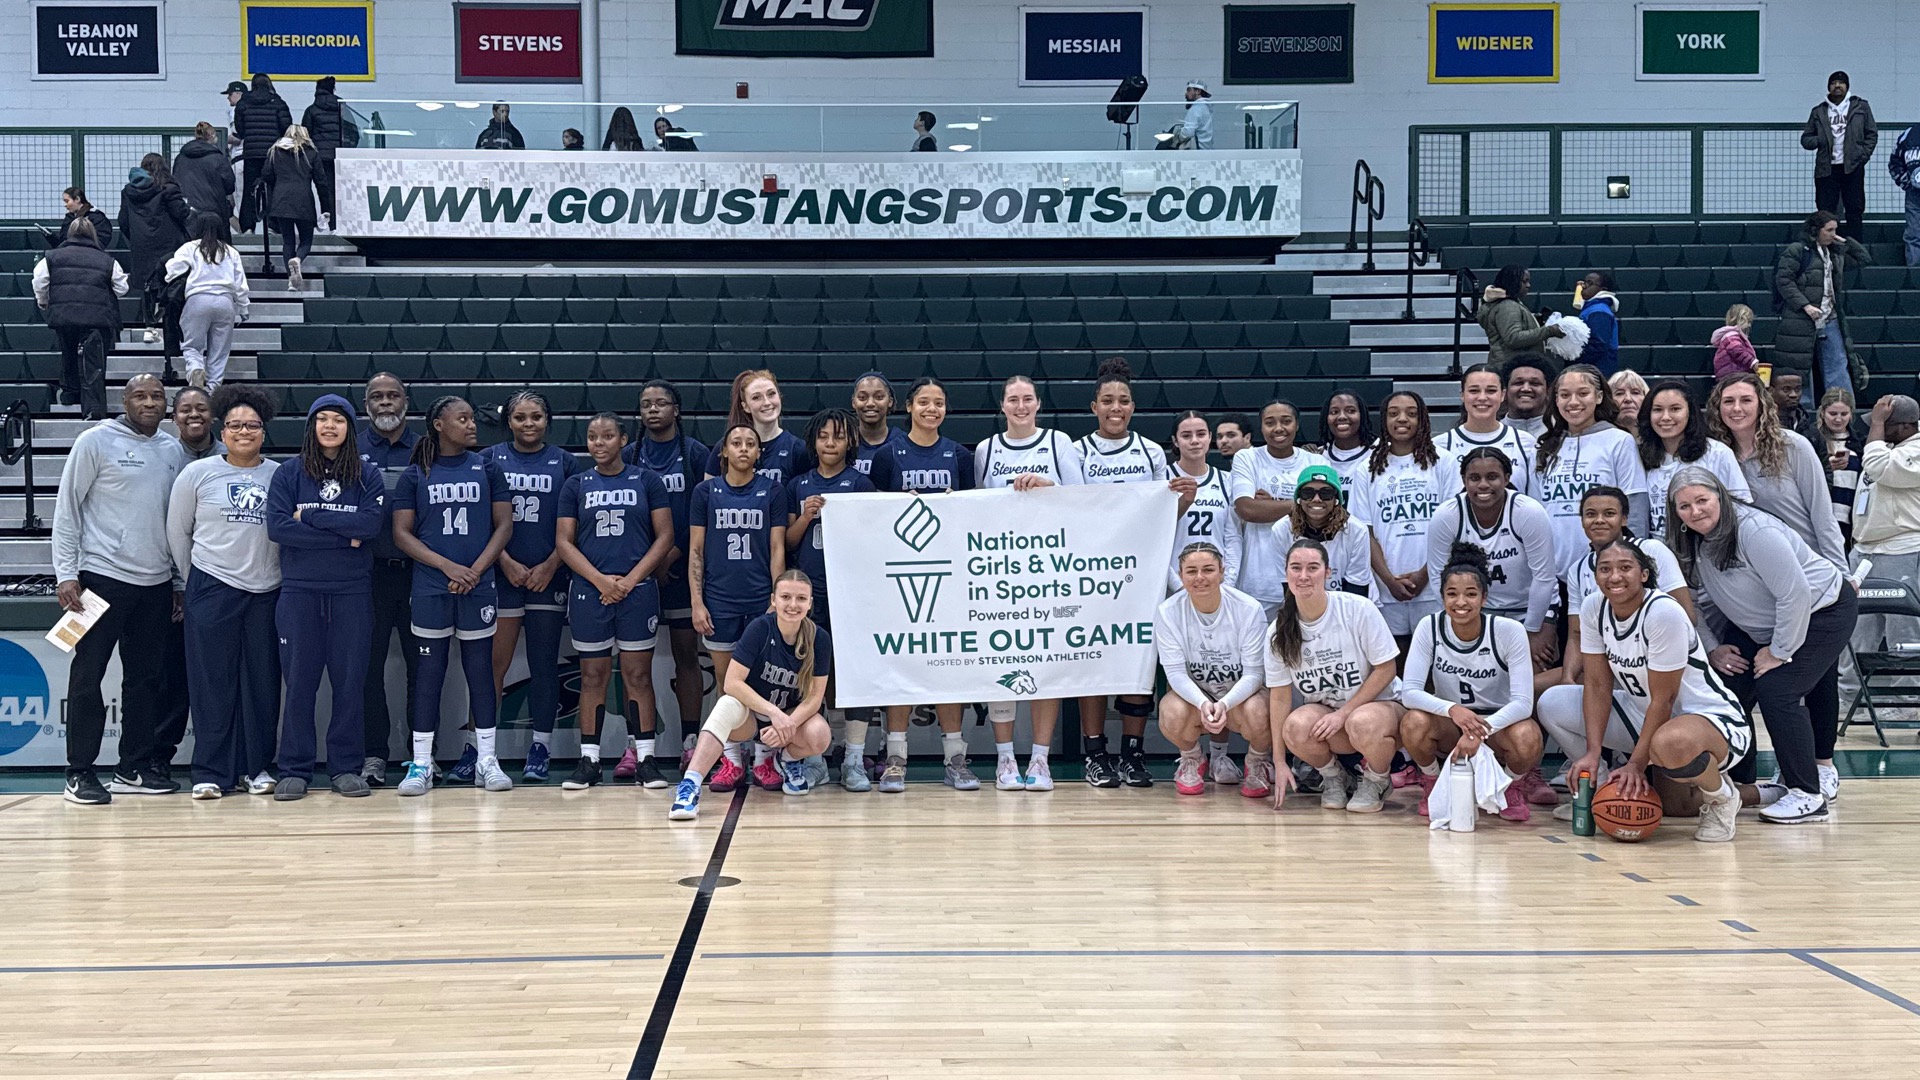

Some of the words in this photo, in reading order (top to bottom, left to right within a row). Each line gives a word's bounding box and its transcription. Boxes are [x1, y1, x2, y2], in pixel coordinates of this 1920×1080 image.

[58, 24, 138, 38] LEBANON
[66, 42, 131, 56] VALLEY
[255, 34, 361, 47] MISERICORDIA
[478, 35, 563, 51] STEVENS
[1048, 38, 1121, 53] MESSIAH
[1238, 36, 1342, 53] STEVENSON
[1456, 36, 1534, 50] WIDENER
[1676, 34, 1726, 49] YORK
[367, 185, 1278, 225] WWW.GOMUSTANGSPORTS.COM
[992, 462, 1049, 477] Stevenson
[1088, 464, 1146, 478] Stevenson
[504, 472, 552, 493] HOOD
[660, 473, 685, 492] OD
[902, 469, 951, 490] HOOD
[1547, 474, 1570, 484] HITE
[1574, 473, 1600, 483] OUT
[428, 482, 480, 504] HOOD
[585, 489, 637, 509] HOOD
[1377, 493, 1411, 508] WHITE
[1415, 493, 1438, 502] OUT
[1542, 482, 1601, 502] GAM
[239, 509, 267, 519] COLLEG
[321, 503, 358, 512] COLLEGE
[512, 495, 540, 522] 32
[1650, 507, 1665, 515] HIT
[228, 516, 262, 525] BLAZERS
[443, 507, 468, 535] 14
[595, 509, 625, 537] 25
[715, 509, 763, 529] HOOD
[1187, 511, 1213, 536] 22
[727, 533, 752, 560] 21
[967, 528, 1066, 551] National
[967, 556, 1021, 576] Girls
[1028, 554, 1044, 573] &
[1050, 552, 1137, 572] Women
[968, 582, 988, 600] in
[996, 579, 1071, 604] Sports
[1330, 580, 1342, 589] OU
[968, 608, 1032, 622] Powered
[1034, 608, 1050, 622] by
[873, 631, 978, 655] WHITE
[989, 627, 1054, 651] OUT
[1065, 622, 1153, 647] GAME
[927, 658, 962, 667] HOSTED
[964, 657, 976, 666] BY
[978, 654, 1043, 665] STEVENSON
[1046, 651, 1102, 663] ATHLETICS
[1187, 661, 1219, 672] WHIE
[760, 661, 799, 689] HOO
[1295, 665, 1333, 680] WHITE
[1436, 657, 1497, 679] Stevenson
[1459, 680, 1475, 704] 9
[1619, 671, 1647, 697] 13
[770, 689, 789, 709] 11
[1606, 805, 1631, 820] ROCK
[1636, 806, 1655, 820] THE
